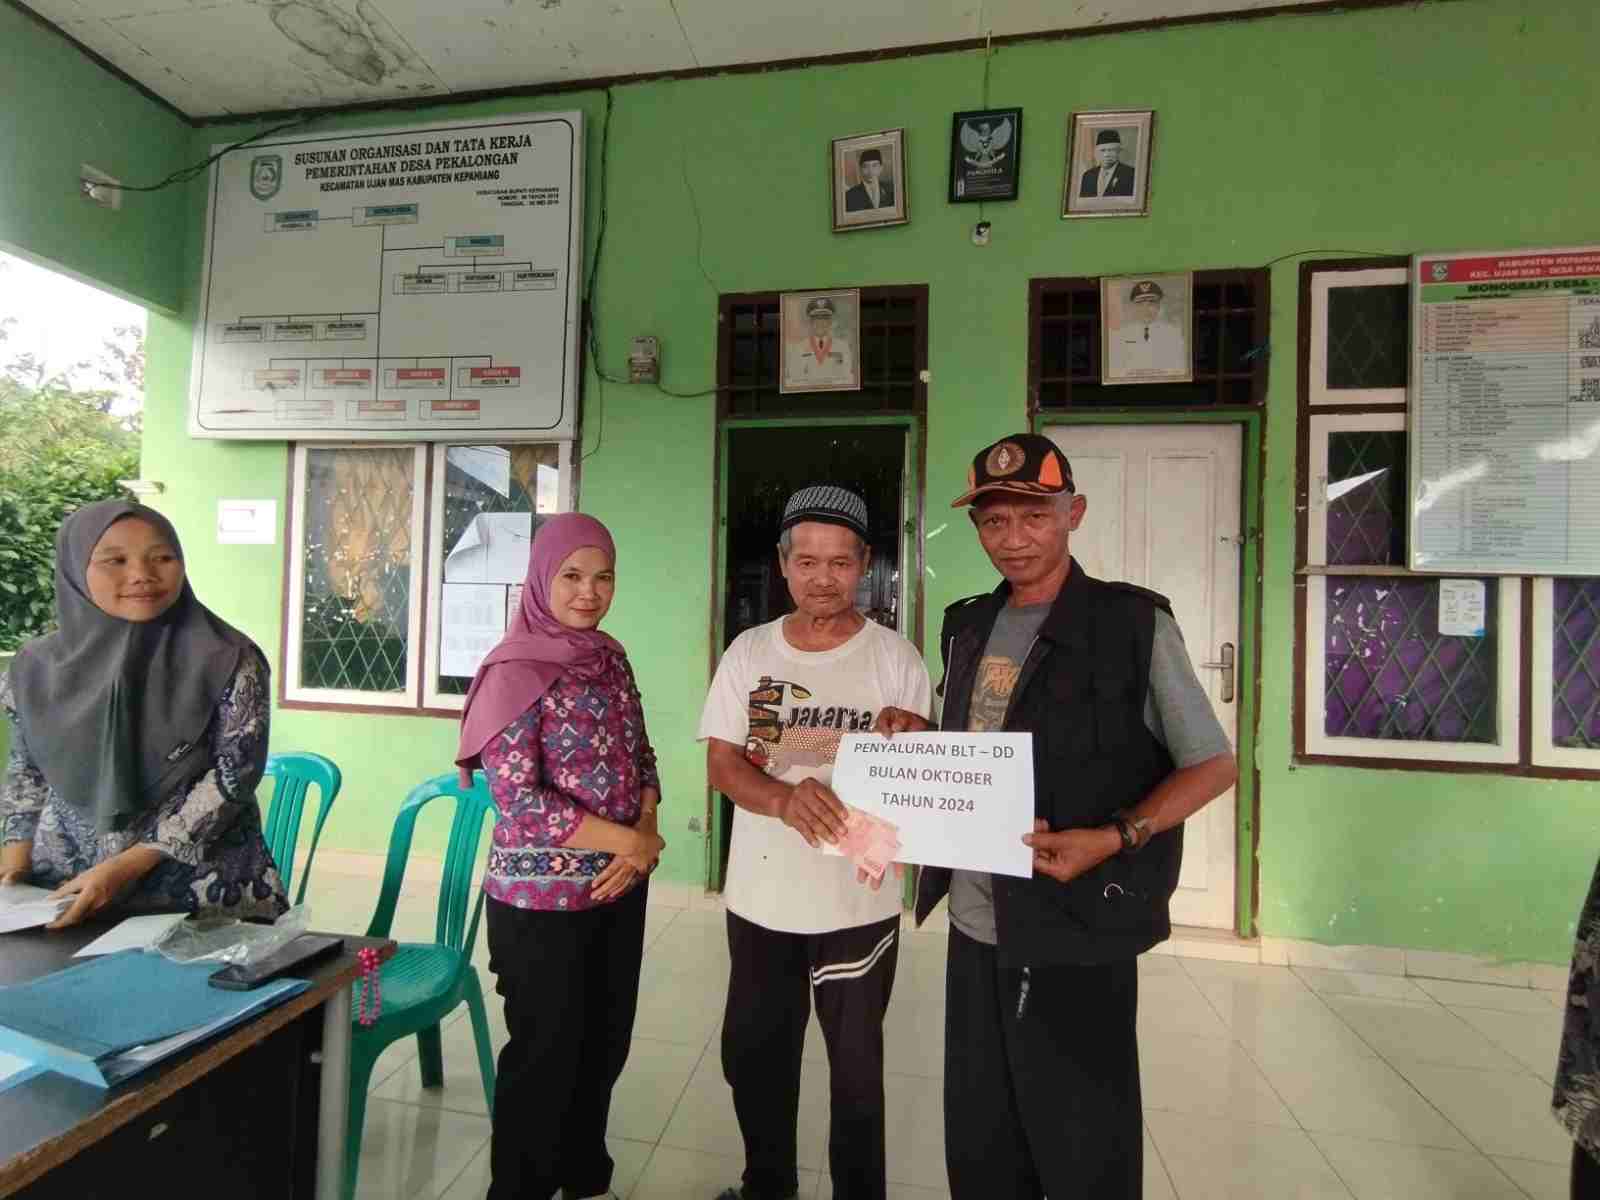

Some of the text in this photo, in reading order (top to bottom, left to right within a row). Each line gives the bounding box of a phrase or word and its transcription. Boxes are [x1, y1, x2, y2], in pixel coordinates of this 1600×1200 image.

[294, 134, 532, 165] SUSUNAN ORGANISASI DAN TATA KERJA
[305, 152, 519, 180] PEMERINTAHAN DESA PEKALONGAN
[319, 170, 500, 192] KECAMATAN UJAN MAS KABUPATEN KEPAHIANG
[1467, 279, 1549, 292] MONOGRAFI
[1553, 278, 1590, 289] DESA
[853, 741, 946, 756] PENYALURAN
[950, 743, 977, 758] BLT
[992, 745, 1014, 758] DD
[868, 765, 992, 786] BULAN OKTOBER
[881, 792, 975, 812] TAHUN 2024
